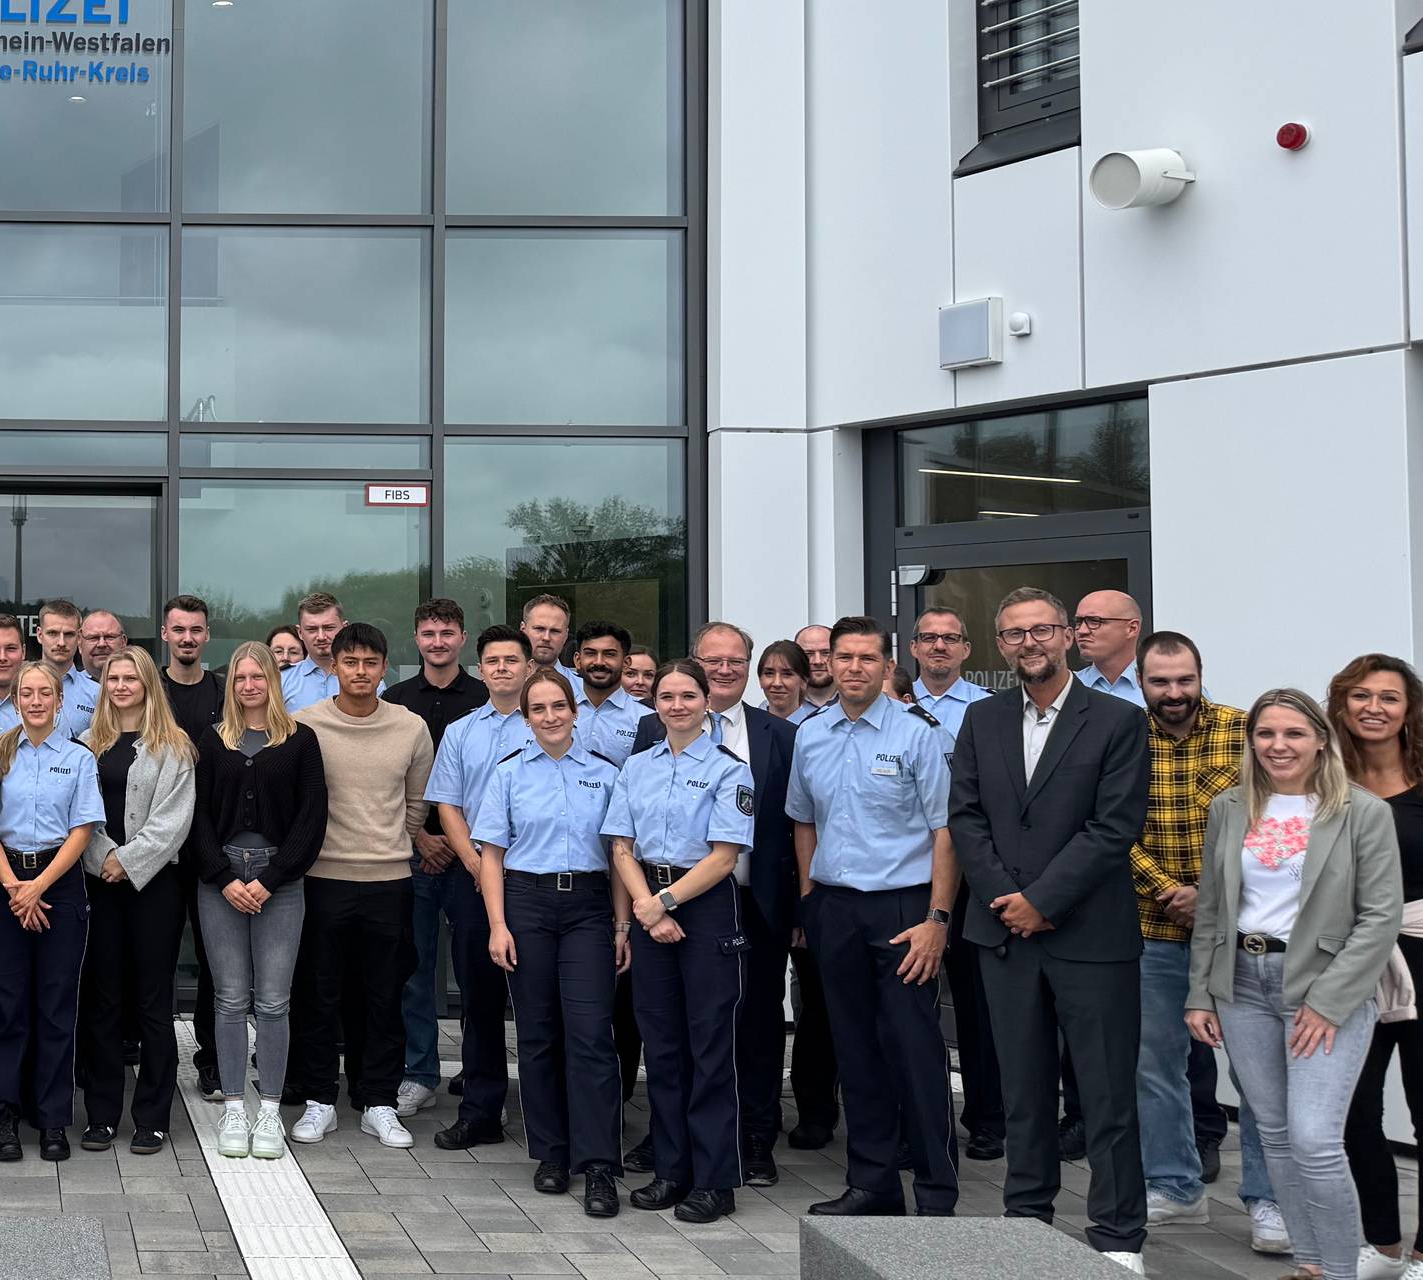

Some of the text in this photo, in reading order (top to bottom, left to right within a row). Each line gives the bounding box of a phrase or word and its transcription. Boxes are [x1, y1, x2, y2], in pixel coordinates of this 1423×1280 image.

[385, 490, 410, 500] FIBS
[616, 729, 637, 739] POLIZE
[49, 766, 71, 775] POLIZEI
